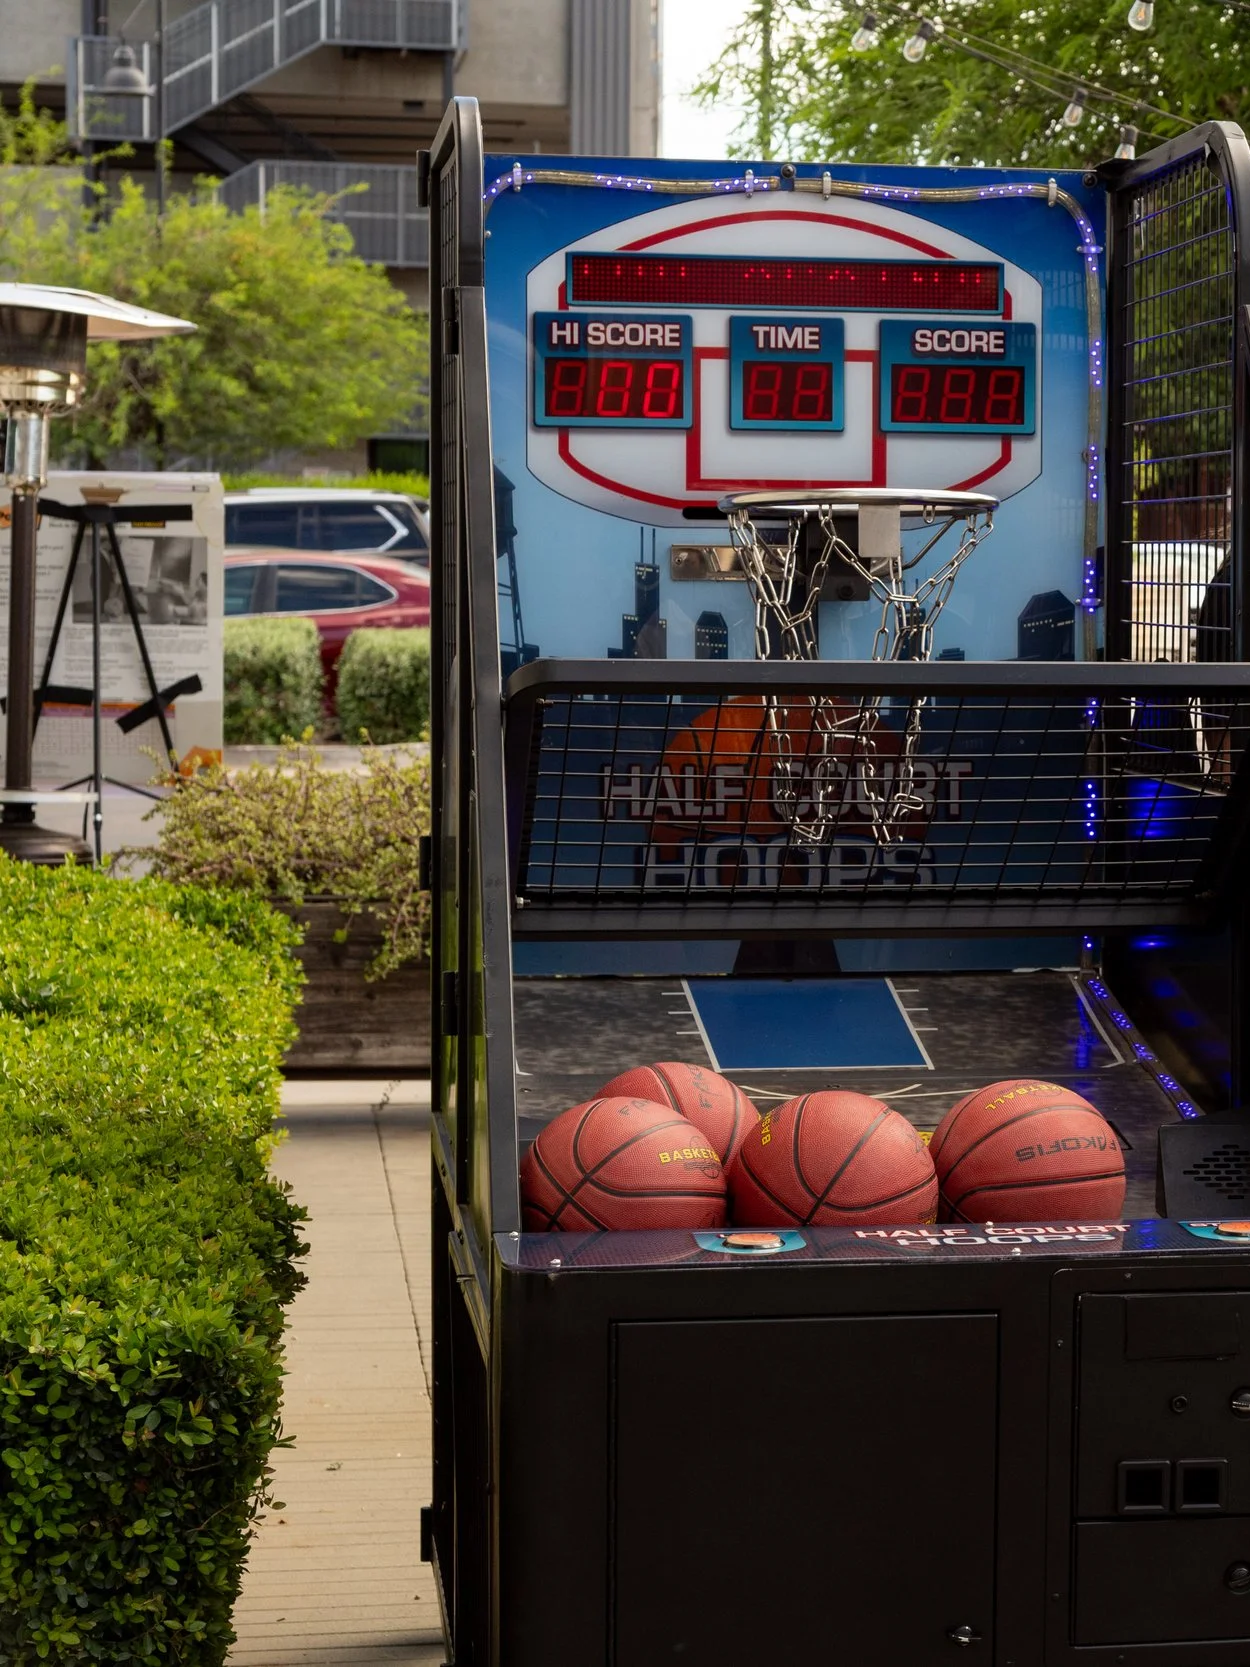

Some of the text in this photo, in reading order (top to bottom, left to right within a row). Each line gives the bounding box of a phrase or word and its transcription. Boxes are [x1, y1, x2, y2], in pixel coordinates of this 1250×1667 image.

[550, 321, 682, 349] HI SCORE
[752, 324, 820, 350] TIME
[914, 328, 1005, 354] SCORE
[601, 760, 974, 817] HALF COURT
[640, 835, 937, 887] HOOPS
[855, 1224, 1132, 1239] HALF COURT
[897, 1233, 1116, 1246] HOOPS
